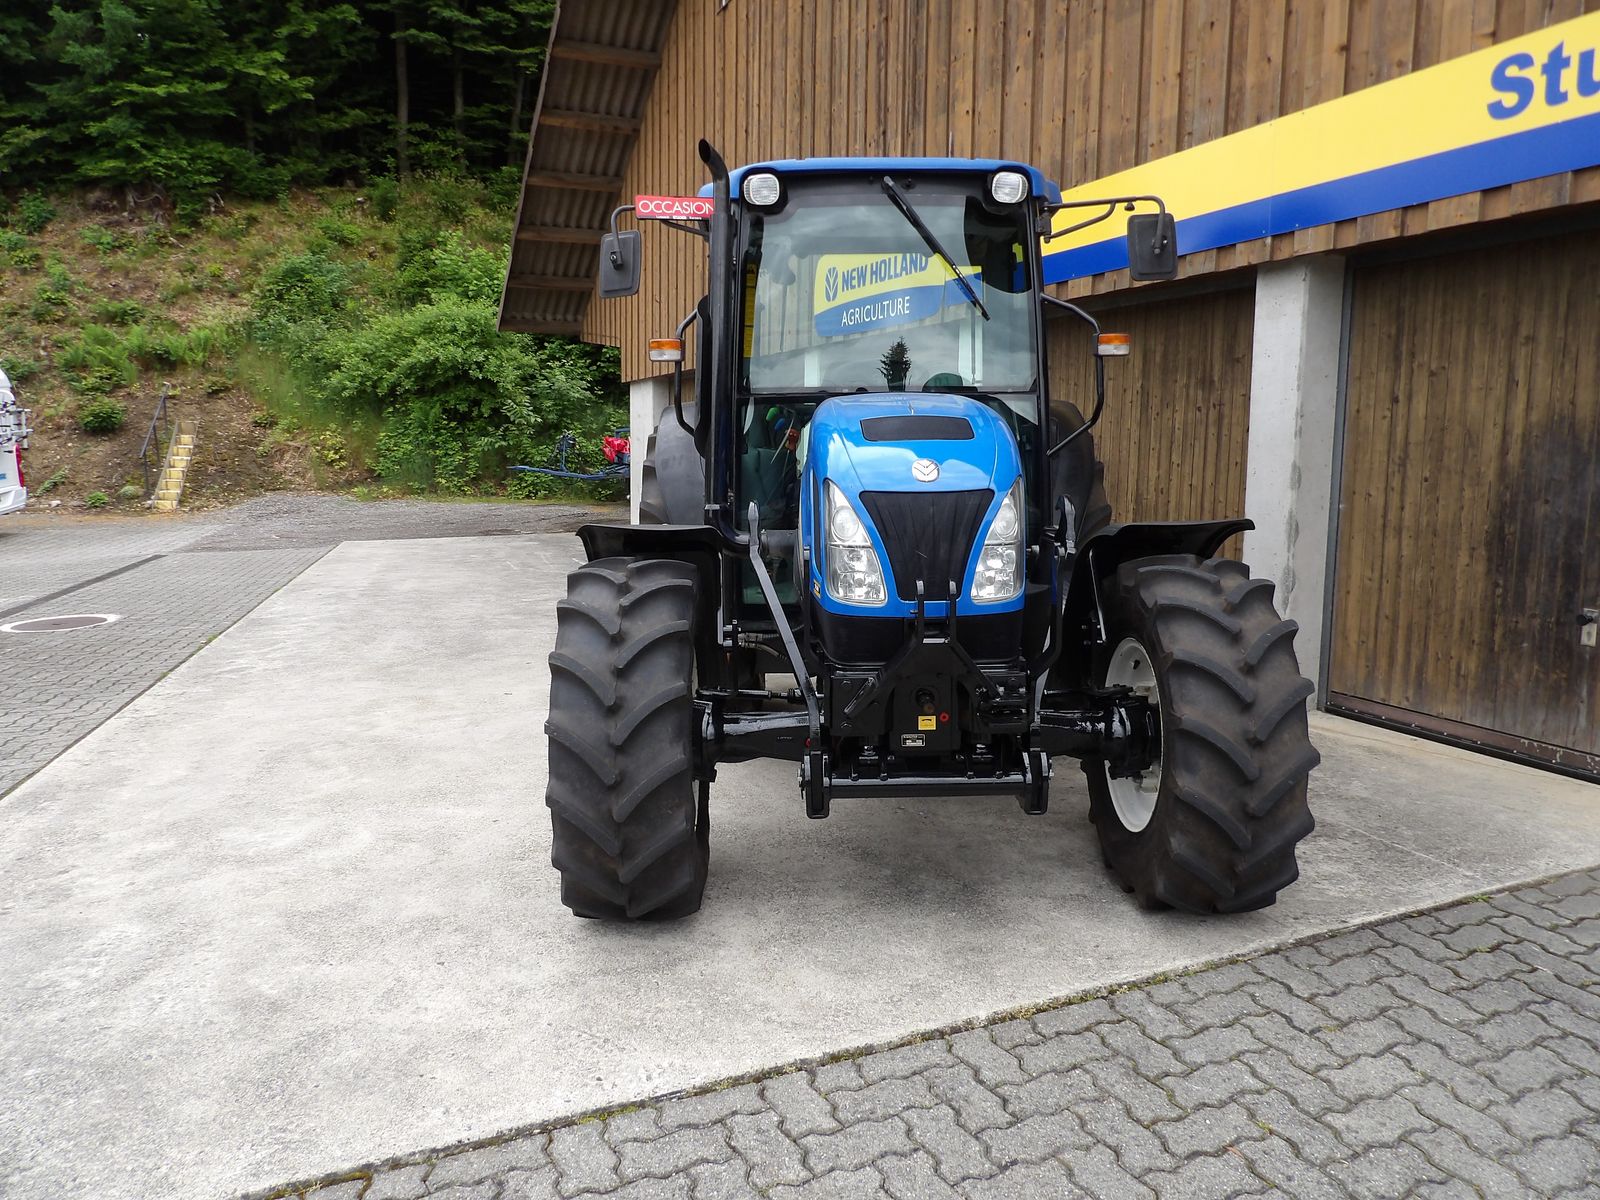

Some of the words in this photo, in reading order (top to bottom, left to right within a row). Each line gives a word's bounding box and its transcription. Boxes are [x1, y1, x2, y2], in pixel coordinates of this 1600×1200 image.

[841, 264, 868, 292] NEW
[870, 253, 929, 285] HOLLAND
[841, 296, 911, 327] AGRICULTURE
